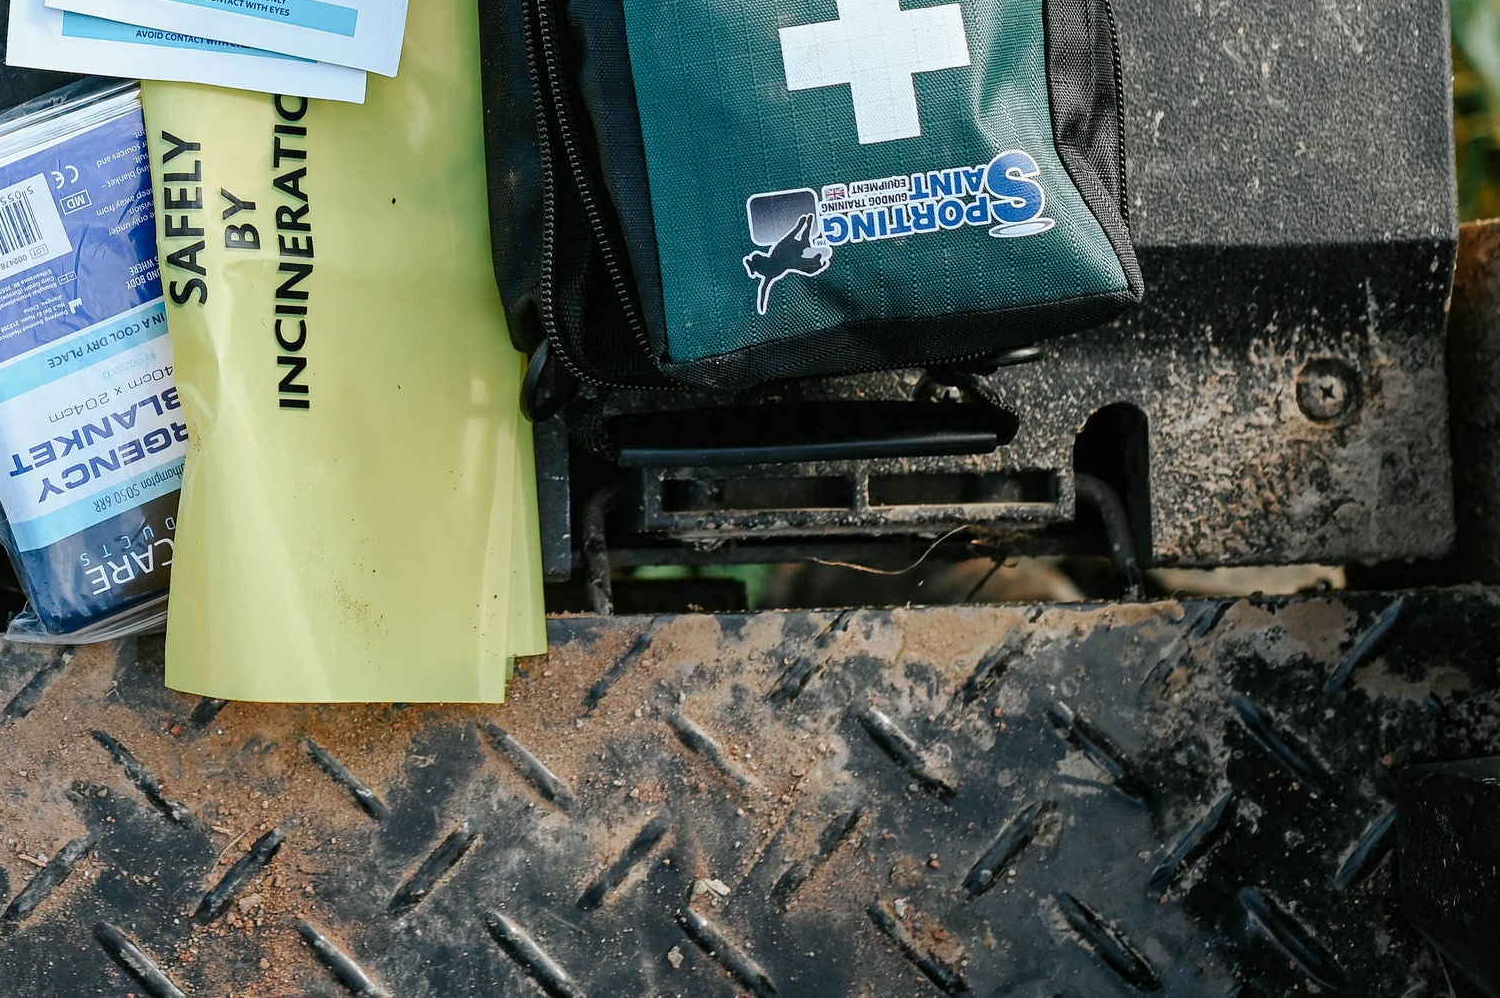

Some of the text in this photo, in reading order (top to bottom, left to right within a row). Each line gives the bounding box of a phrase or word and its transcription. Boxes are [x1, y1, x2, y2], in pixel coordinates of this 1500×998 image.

[245, 0, 268, 12] WITH
[268, 5, 290, 17] EYES
[135, 30, 205, 44] AVOID CONTACT
[95, 143, 141, 168] sources and
[50, 164, 79, 189] CE
[106, 170, 135, 188] blanket
[851, 178, 906, 194] EQUIPMENT
[64, 193, 85, 209] MD
[95, 193, 136, 217] away from
[820, 192, 907, 213] GUNDOG TRAINING
[107, 213, 149, 236] only under
[160, 132, 207, 305] SAFELY
[220, 188, 260, 250] BY
[0, 253, 27, 270] 002478
[128, 257, 154, 275] WHERE
[141, 318, 150, 329] A
[151, 312, 164, 325] IN
[108, 323, 141, 342] COOL
[85, 336, 108, 353] DRY
[47, 346, 84, 369] PLACE
[113, 386, 122, 396] x
[48, 392, 109, 423] 204cm
[92, 495, 112, 513] 6RR
